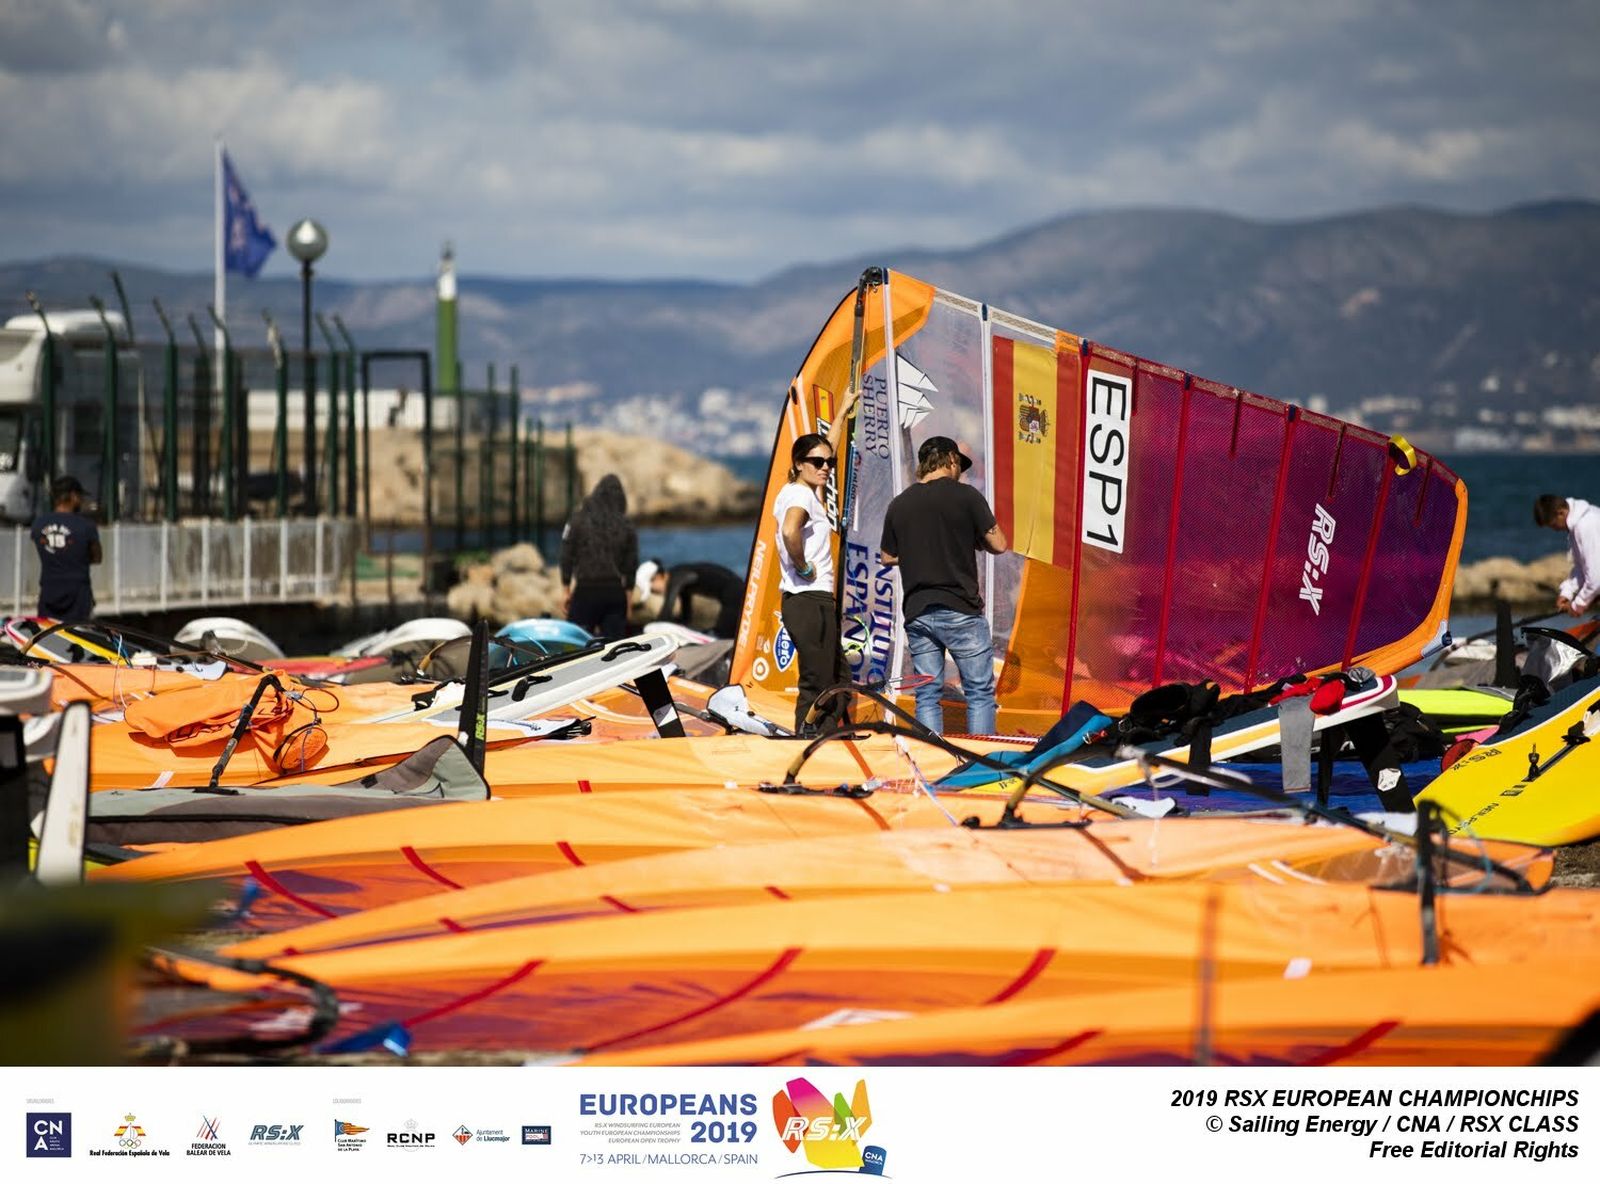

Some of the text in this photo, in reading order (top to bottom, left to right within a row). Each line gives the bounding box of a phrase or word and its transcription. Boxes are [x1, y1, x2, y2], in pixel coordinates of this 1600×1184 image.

[862, 373, 878, 456] SHERRY
[873, 377, 890, 460] PUERTO
[1087, 376, 1127, 546] ESP1
[738, 540, 766, 648] NEILPRYDE
[1299, 503, 1336, 616] RS:X
